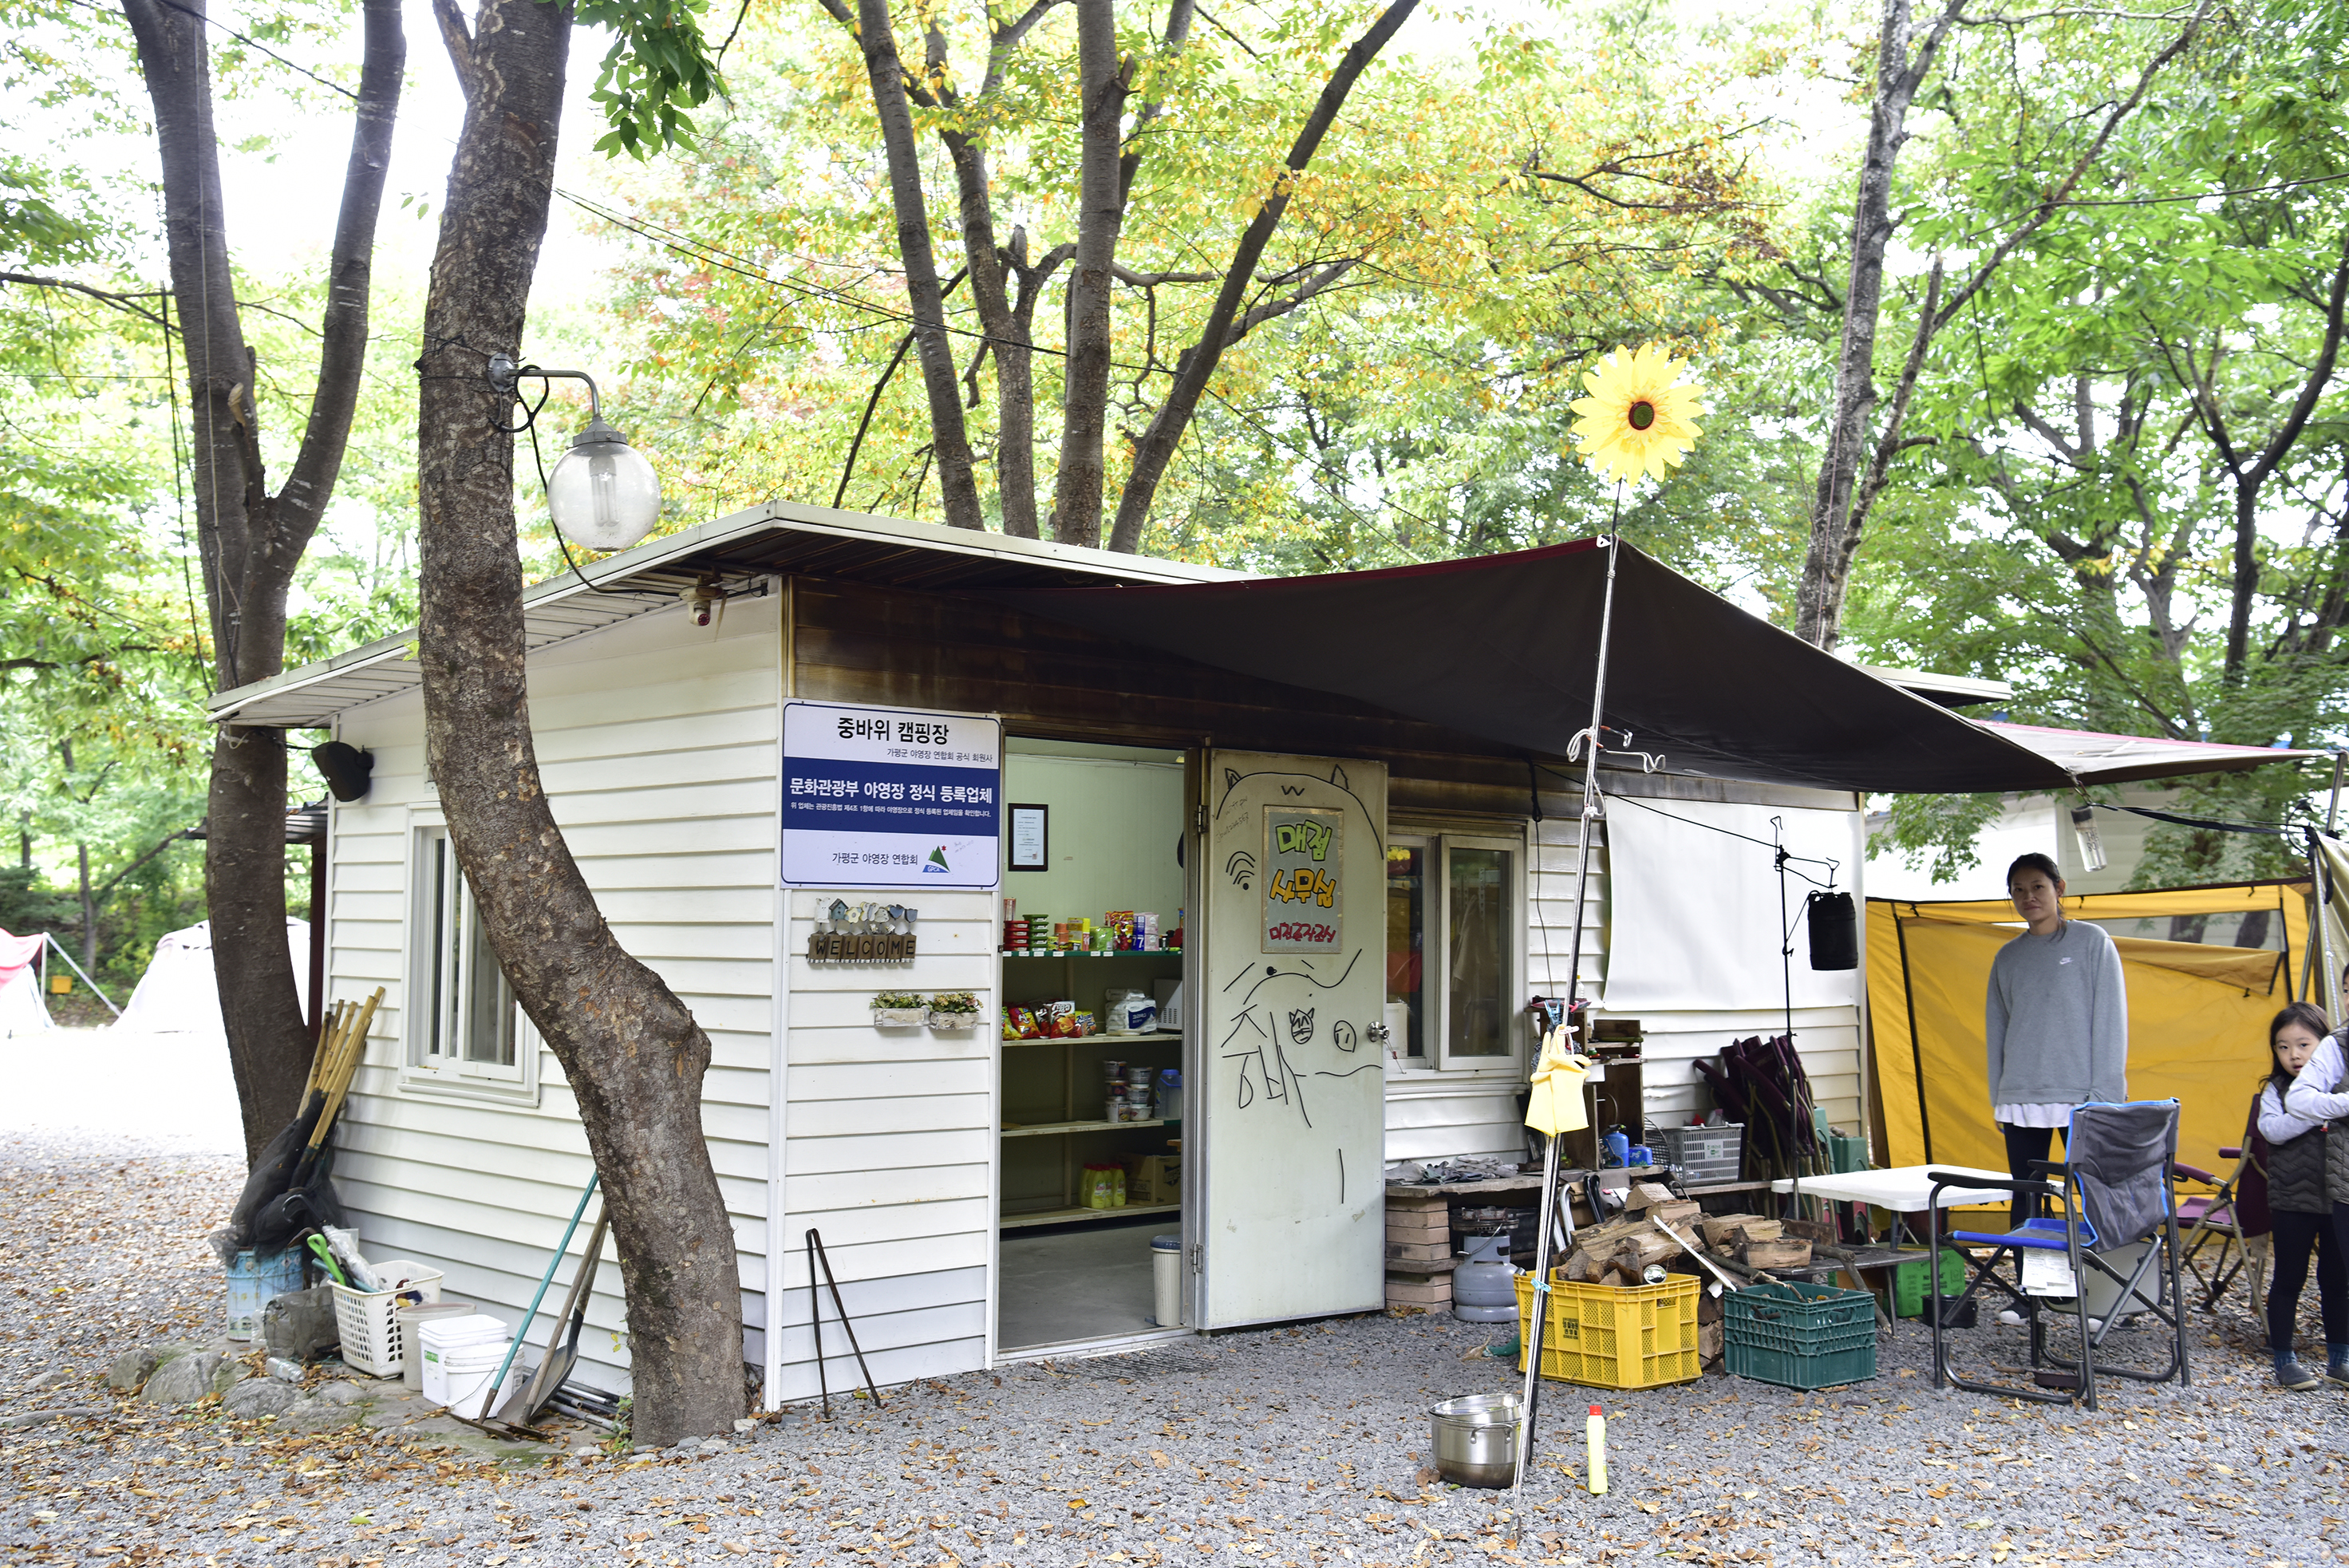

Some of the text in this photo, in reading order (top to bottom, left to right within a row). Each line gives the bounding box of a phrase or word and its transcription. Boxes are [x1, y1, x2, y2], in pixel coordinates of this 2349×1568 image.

[837, 717, 949, 745] 중바위 캠핑장
[886, 748, 993, 763] 가평군 야영장 연합회 공식 회원사
[789, 777, 993, 804] 문화관광부 야영장 정식 등록업체
[1275, 819, 1332, 862] 매점
[831, 852, 918, 865] 가평군 야영장 연합회
[1269, 867, 1337, 908] 사무실
[815, 940, 915, 955] WELCOME
